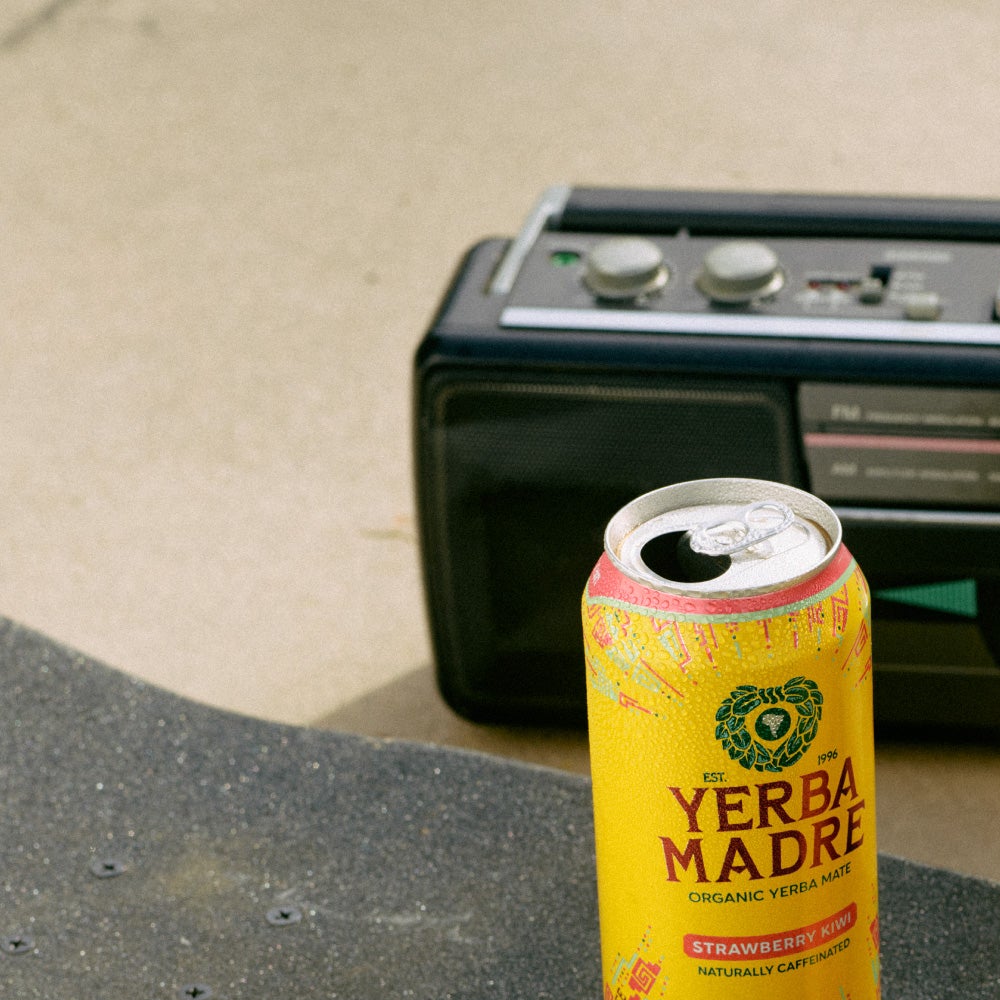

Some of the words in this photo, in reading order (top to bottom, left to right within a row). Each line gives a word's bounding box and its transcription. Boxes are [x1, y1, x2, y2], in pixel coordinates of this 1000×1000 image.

[703, 771, 727, 784] EST.
[817, 749, 839, 766] 1996
[668, 756, 860, 833] YERBA
[658, 800, 867, 883] MADRE
[688, 889, 765, 905] ORGANIC
[769, 881, 818, 899] YERBA
[821, 863, 852, 889] MATE
[692, 930, 816, 956] STRAWBERRY
[821, 912, 852, 940] KIWI
[697, 964, 774, 979] NATURALLY
[777, 938, 851, 975] CAFFEINATED
